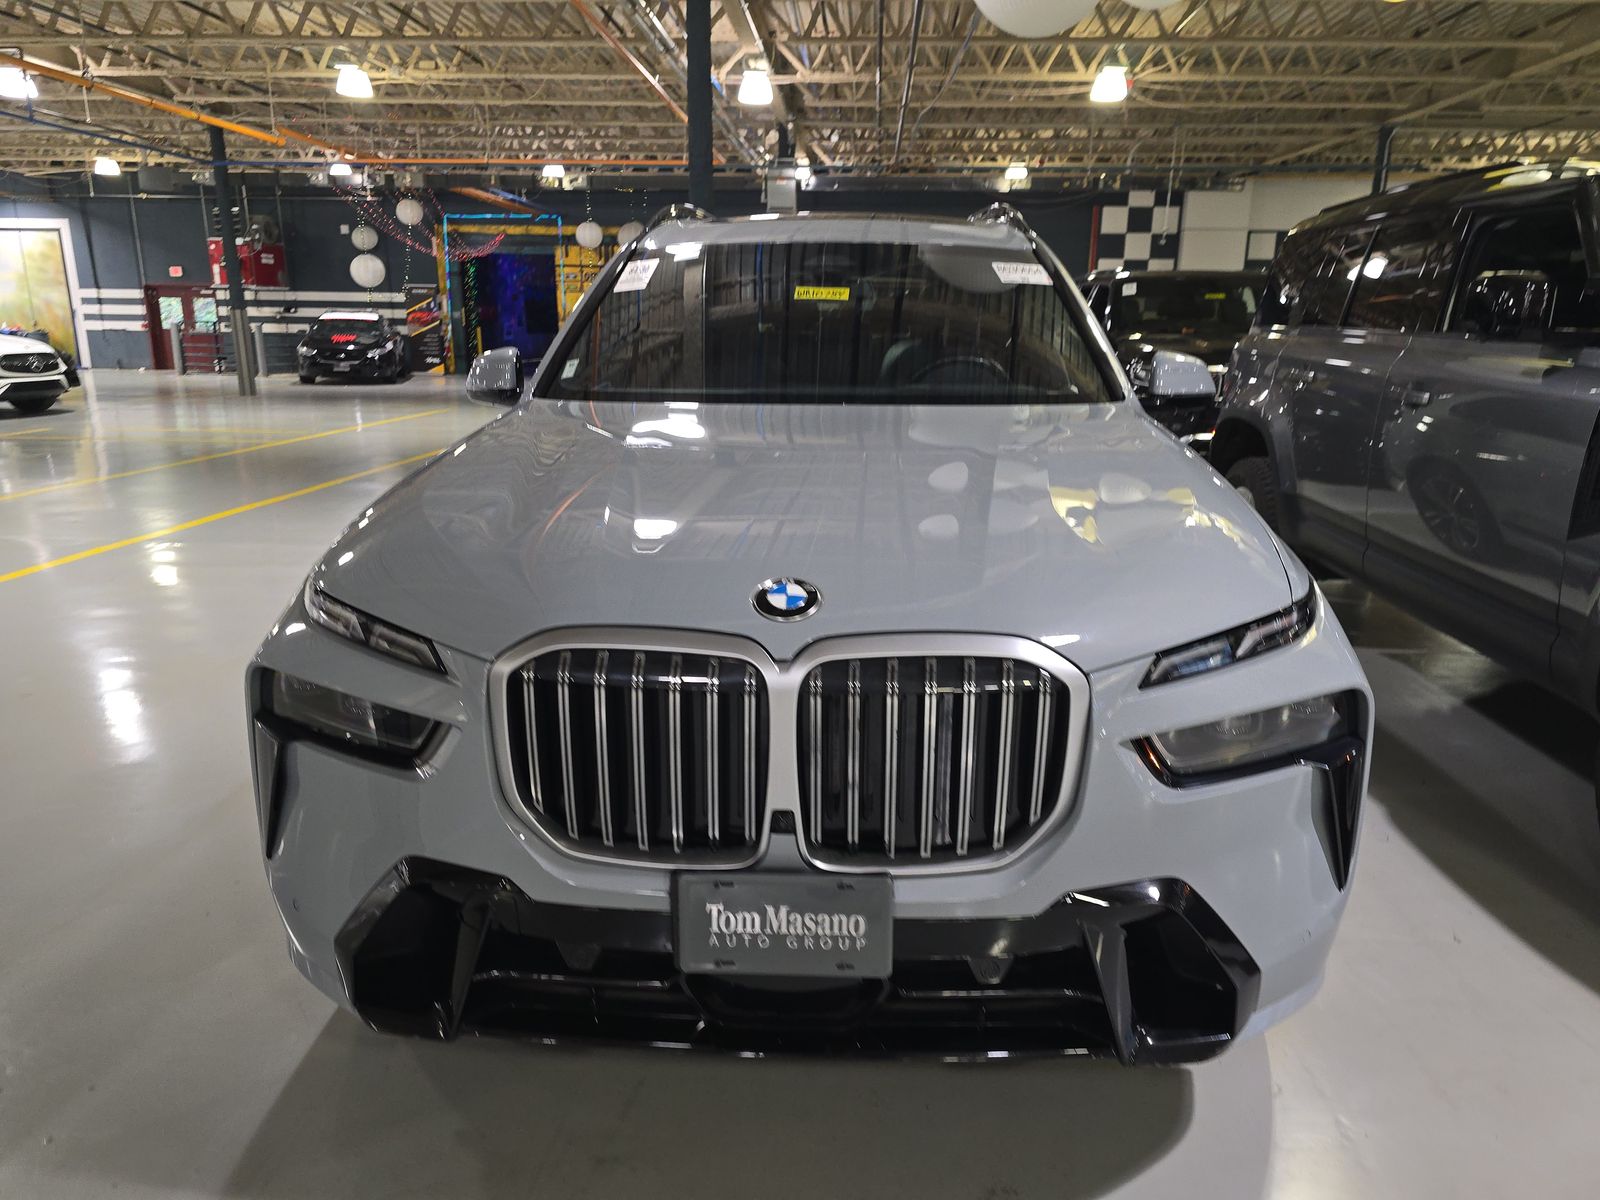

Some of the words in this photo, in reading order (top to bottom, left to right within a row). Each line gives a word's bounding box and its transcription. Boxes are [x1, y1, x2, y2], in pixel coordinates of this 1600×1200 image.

[706, 902, 761, 934] Tom
[763, 904, 866, 938] Masano
[709, 933, 770, 949] AUTO
[785, 935, 866, 951] GROUP
